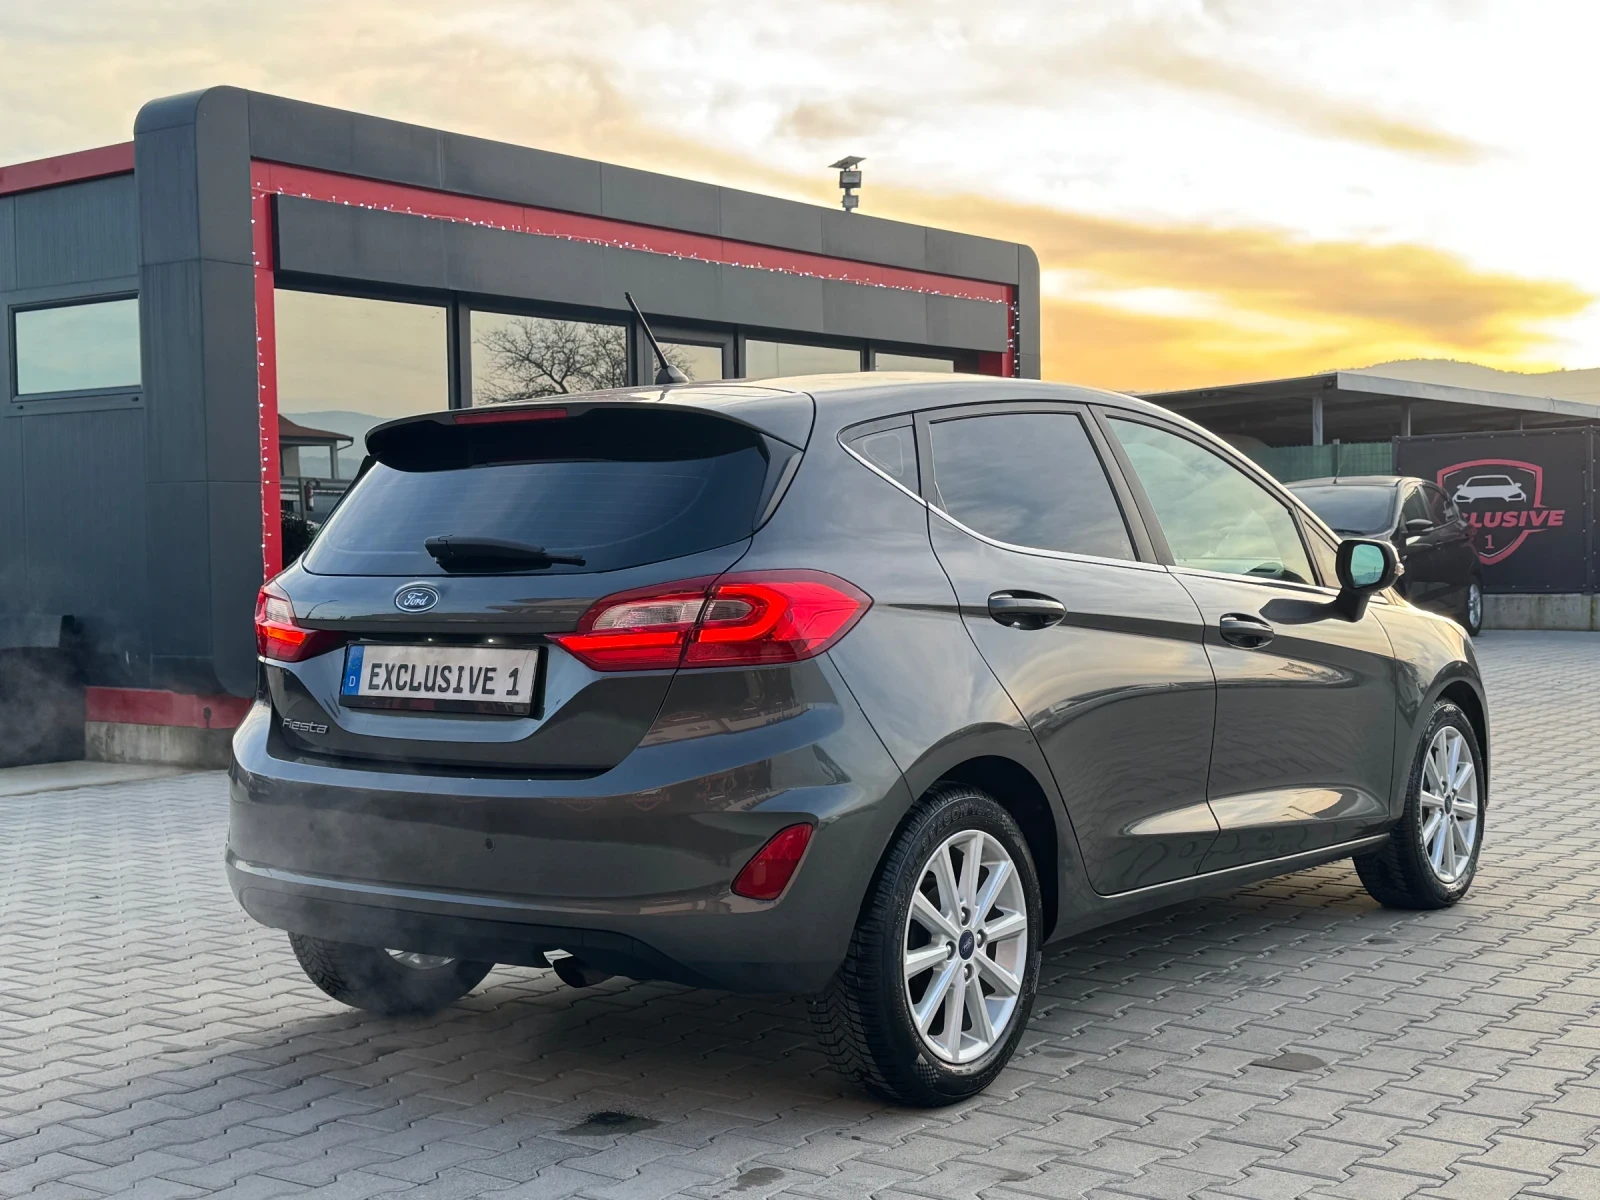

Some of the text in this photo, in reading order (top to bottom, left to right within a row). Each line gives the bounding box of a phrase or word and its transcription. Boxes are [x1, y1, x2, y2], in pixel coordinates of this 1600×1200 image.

[1462, 510, 1565, 528] LUSIVE
[1485, 534, 1495, 549] 1
[404, 592, 429, 606] Ford
[348, 675, 356, 687] D
[368, 662, 520, 696] EXCLUSIVE 1
[282, 717, 328, 734] Fiesta
